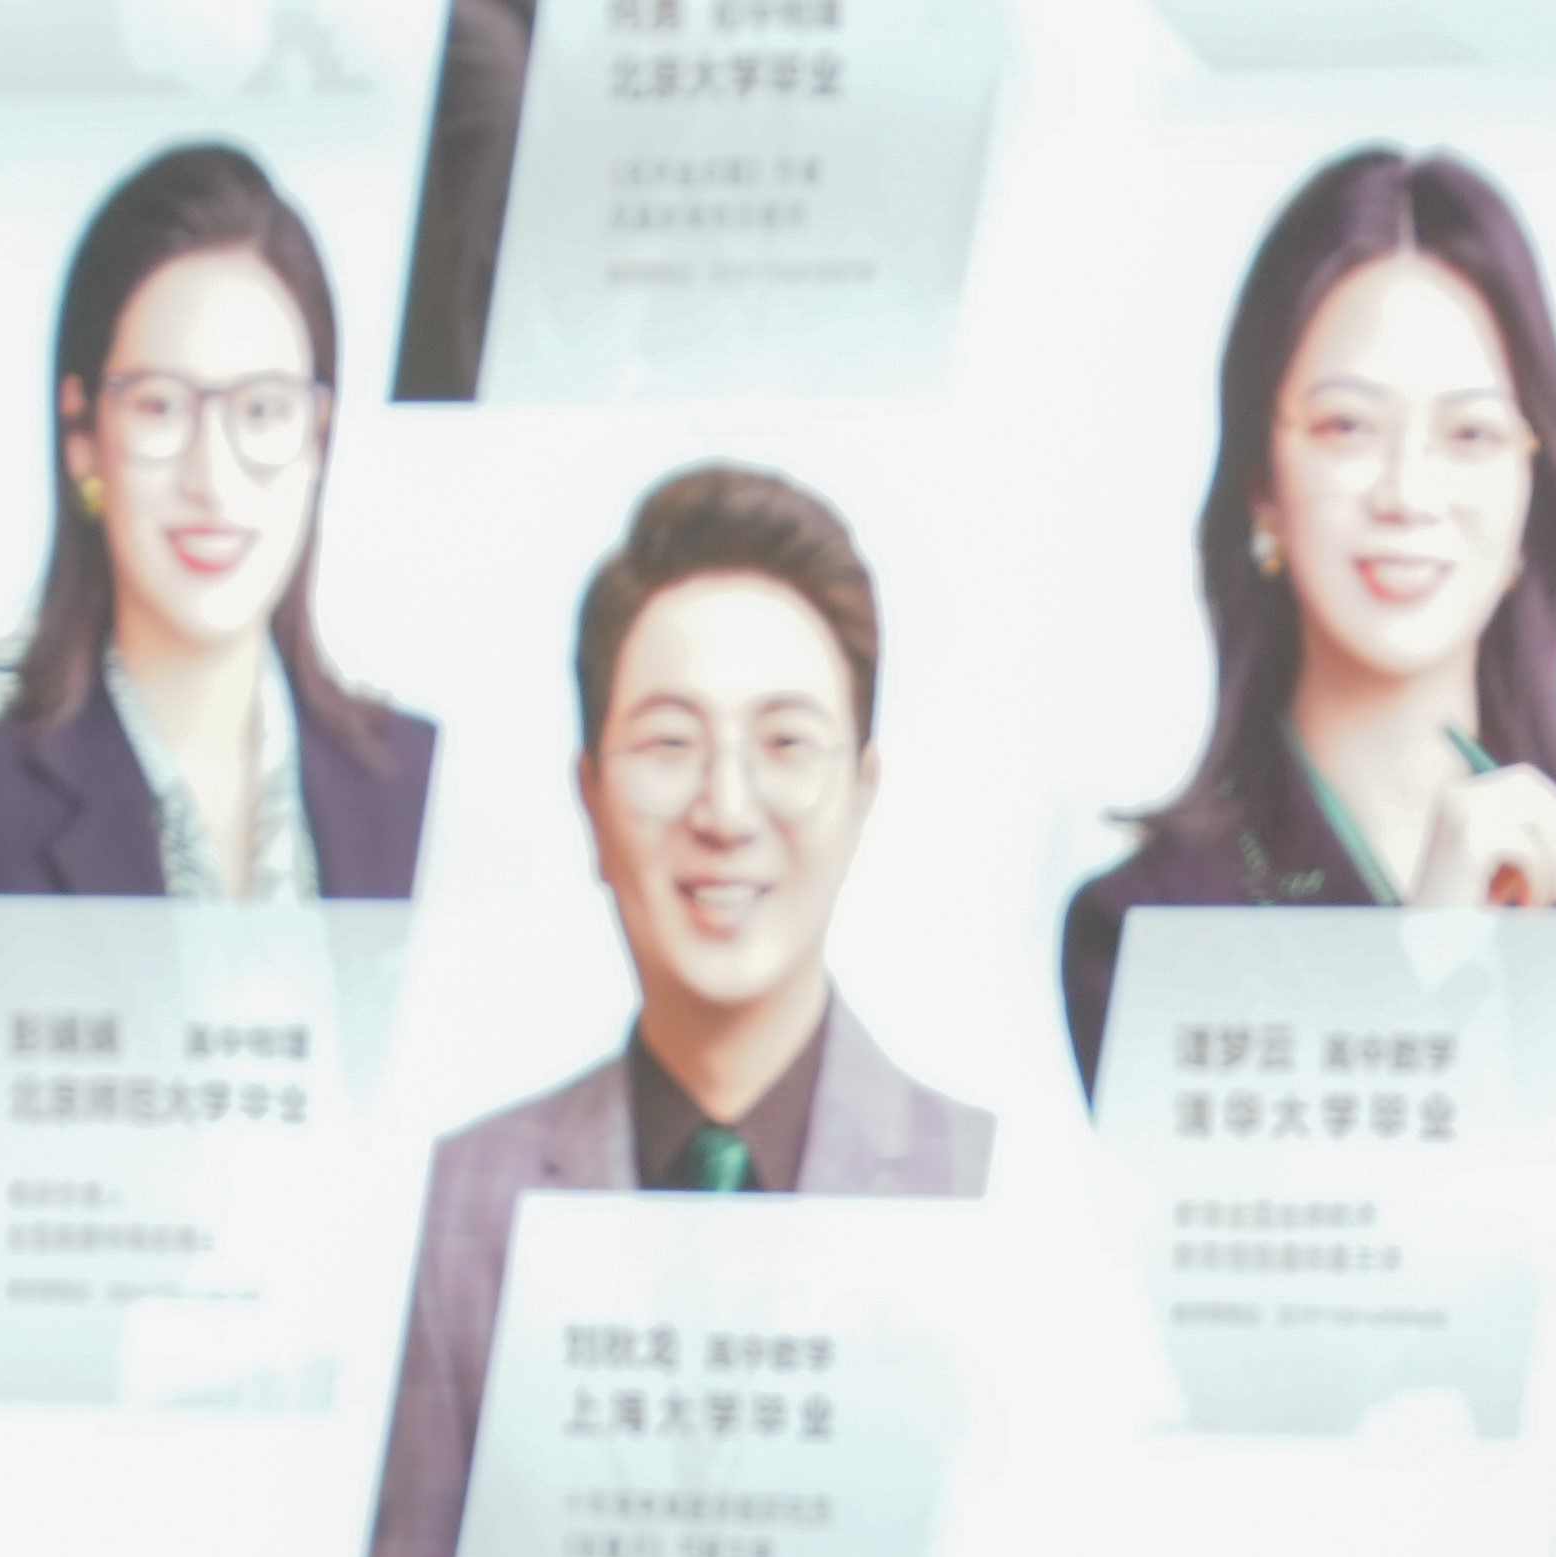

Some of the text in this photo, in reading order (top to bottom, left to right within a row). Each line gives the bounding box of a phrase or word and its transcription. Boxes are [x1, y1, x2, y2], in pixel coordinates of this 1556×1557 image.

[613, 57, 840, 97] 北京大学毕业
[1178, 1096, 1454, 1139] 清华大学毕业
[567, 1394, 831, 1439] 上海大学毕业
